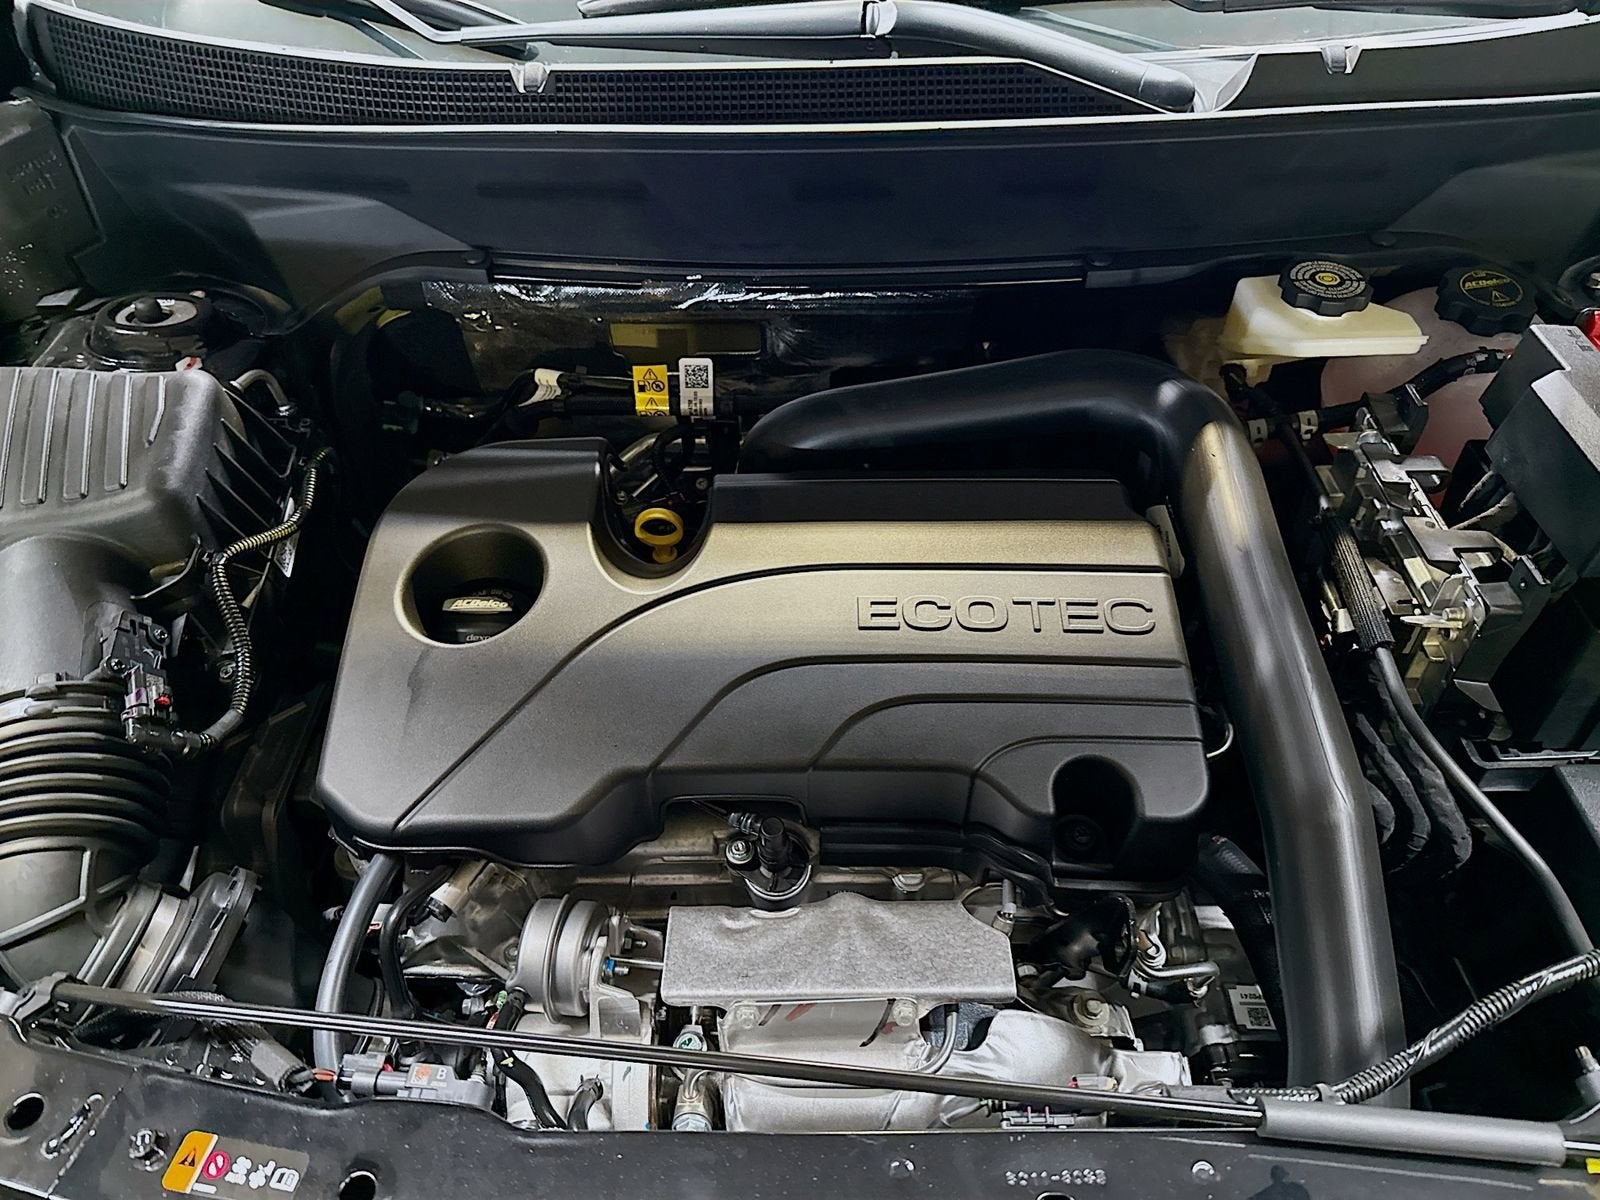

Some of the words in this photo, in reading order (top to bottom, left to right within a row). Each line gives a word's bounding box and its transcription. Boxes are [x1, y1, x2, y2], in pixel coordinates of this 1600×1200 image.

[450, 599, 509, 610] ACDelco
[857, 594, 1156, 636] ECOTEC
[436, 1067, 447, 1080] B
